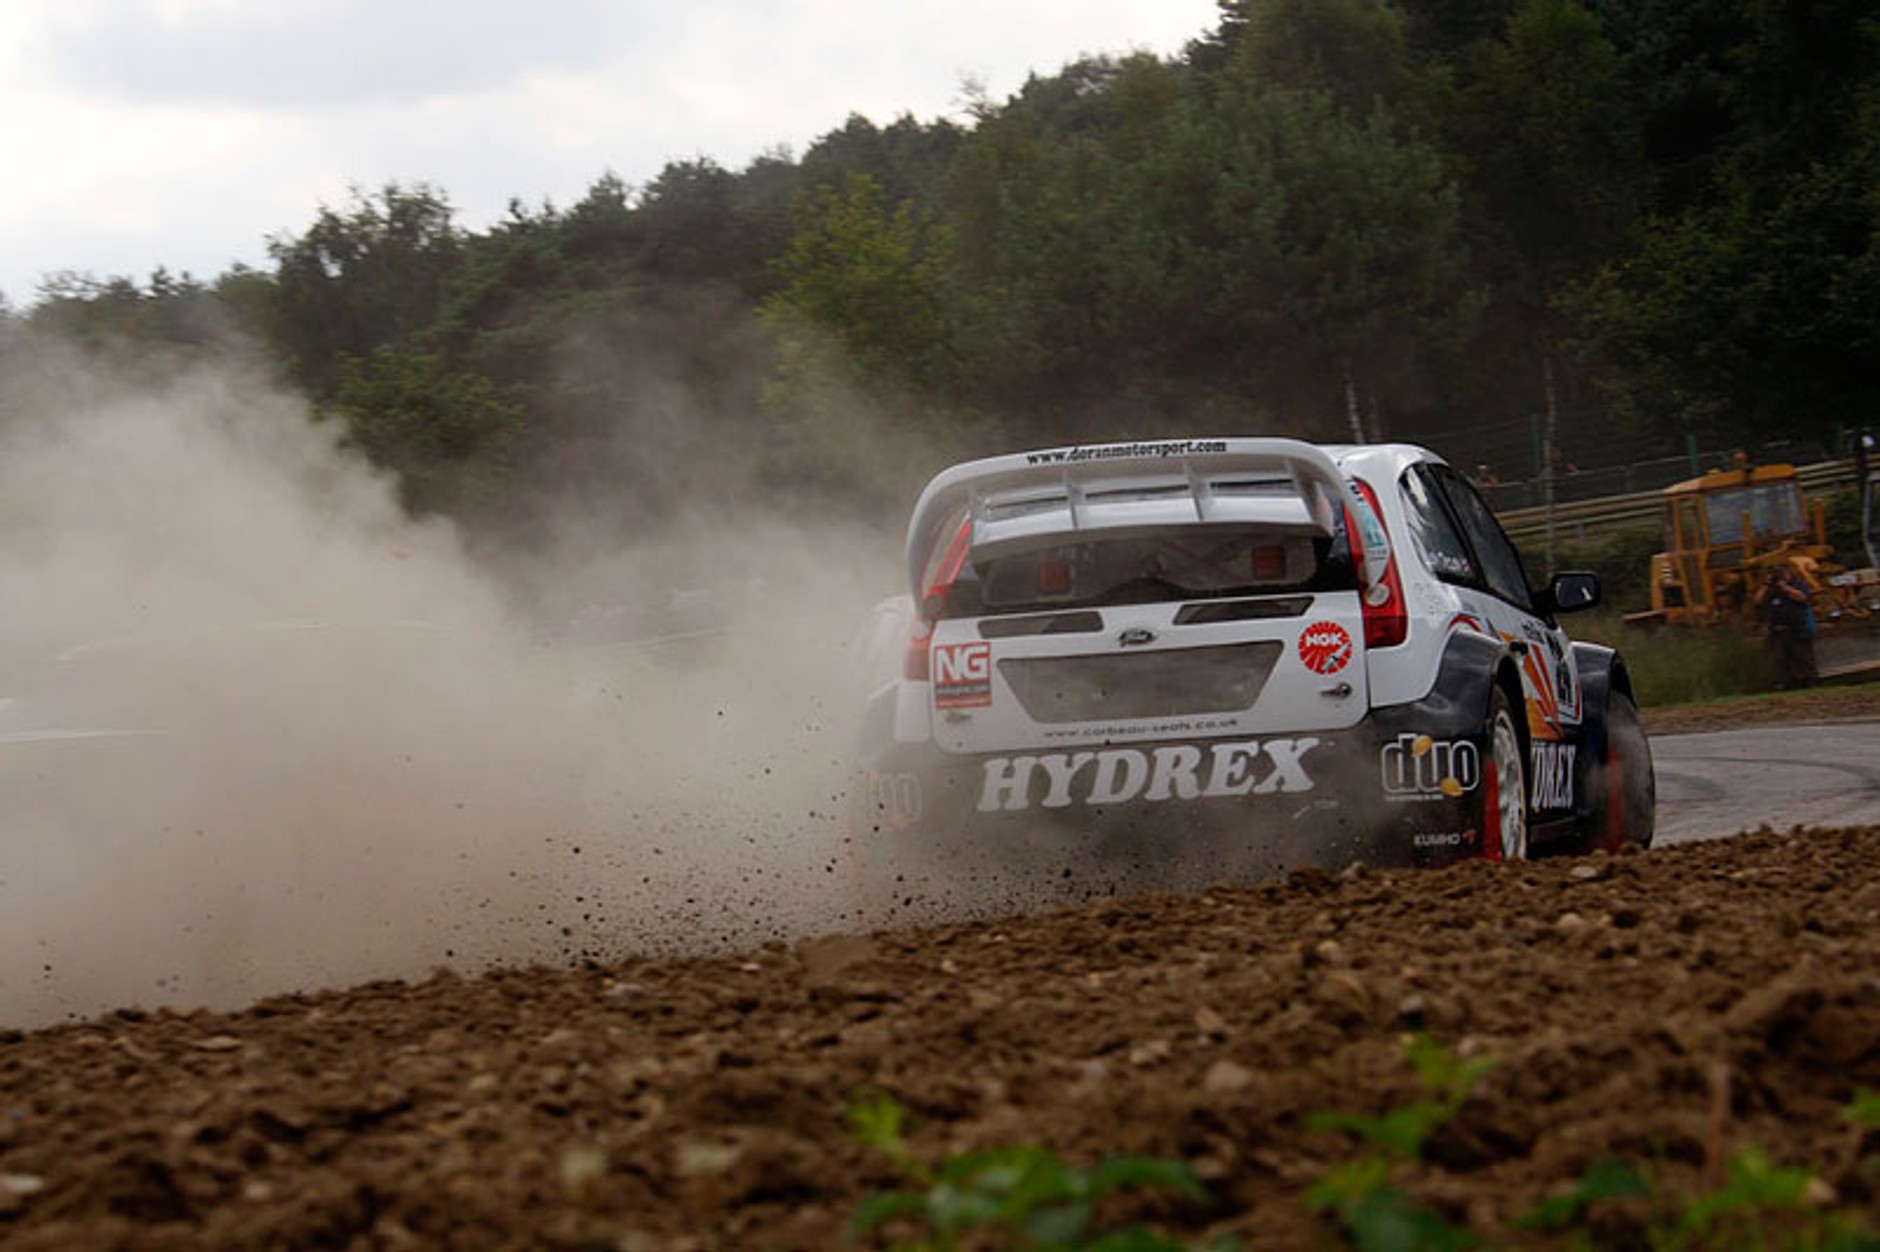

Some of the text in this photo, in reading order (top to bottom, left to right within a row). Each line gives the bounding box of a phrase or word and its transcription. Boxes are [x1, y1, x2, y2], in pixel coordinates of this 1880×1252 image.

[937, 646, 988, 682] NG
[976, 738, 1319, 811] HYDREX
[1382, 733, 1479, 793] duo
